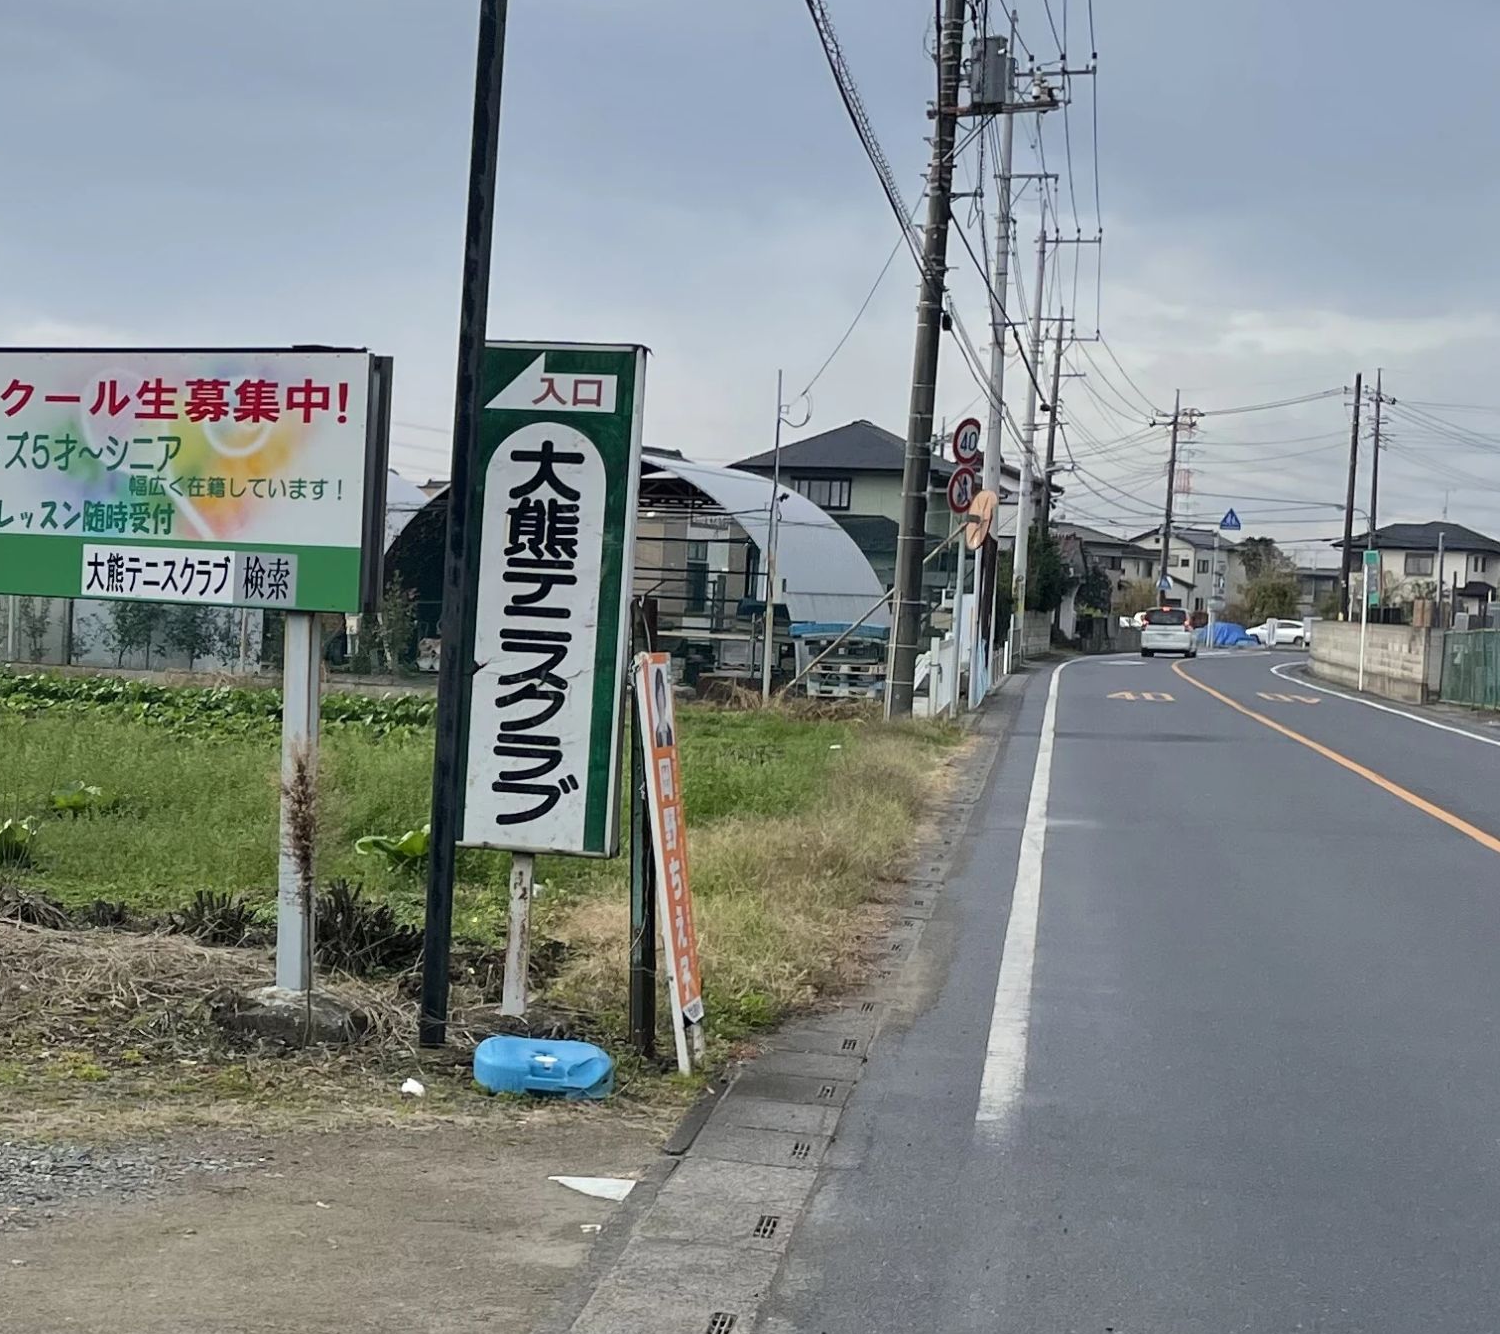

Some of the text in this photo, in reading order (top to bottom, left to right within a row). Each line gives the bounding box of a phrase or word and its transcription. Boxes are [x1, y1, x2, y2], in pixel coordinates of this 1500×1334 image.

[532, 375, 603, 408] 入口
[960, 430, 978, 452] 40
[128, 474, 343, 501] 幅広く在籍しています!
[85, 552, 291, 601] 大熊テニスクラブ 検索
[490, 439, 586, 825] 大熊テニスクラブ
[1106, 690, 1176, 701] 40
